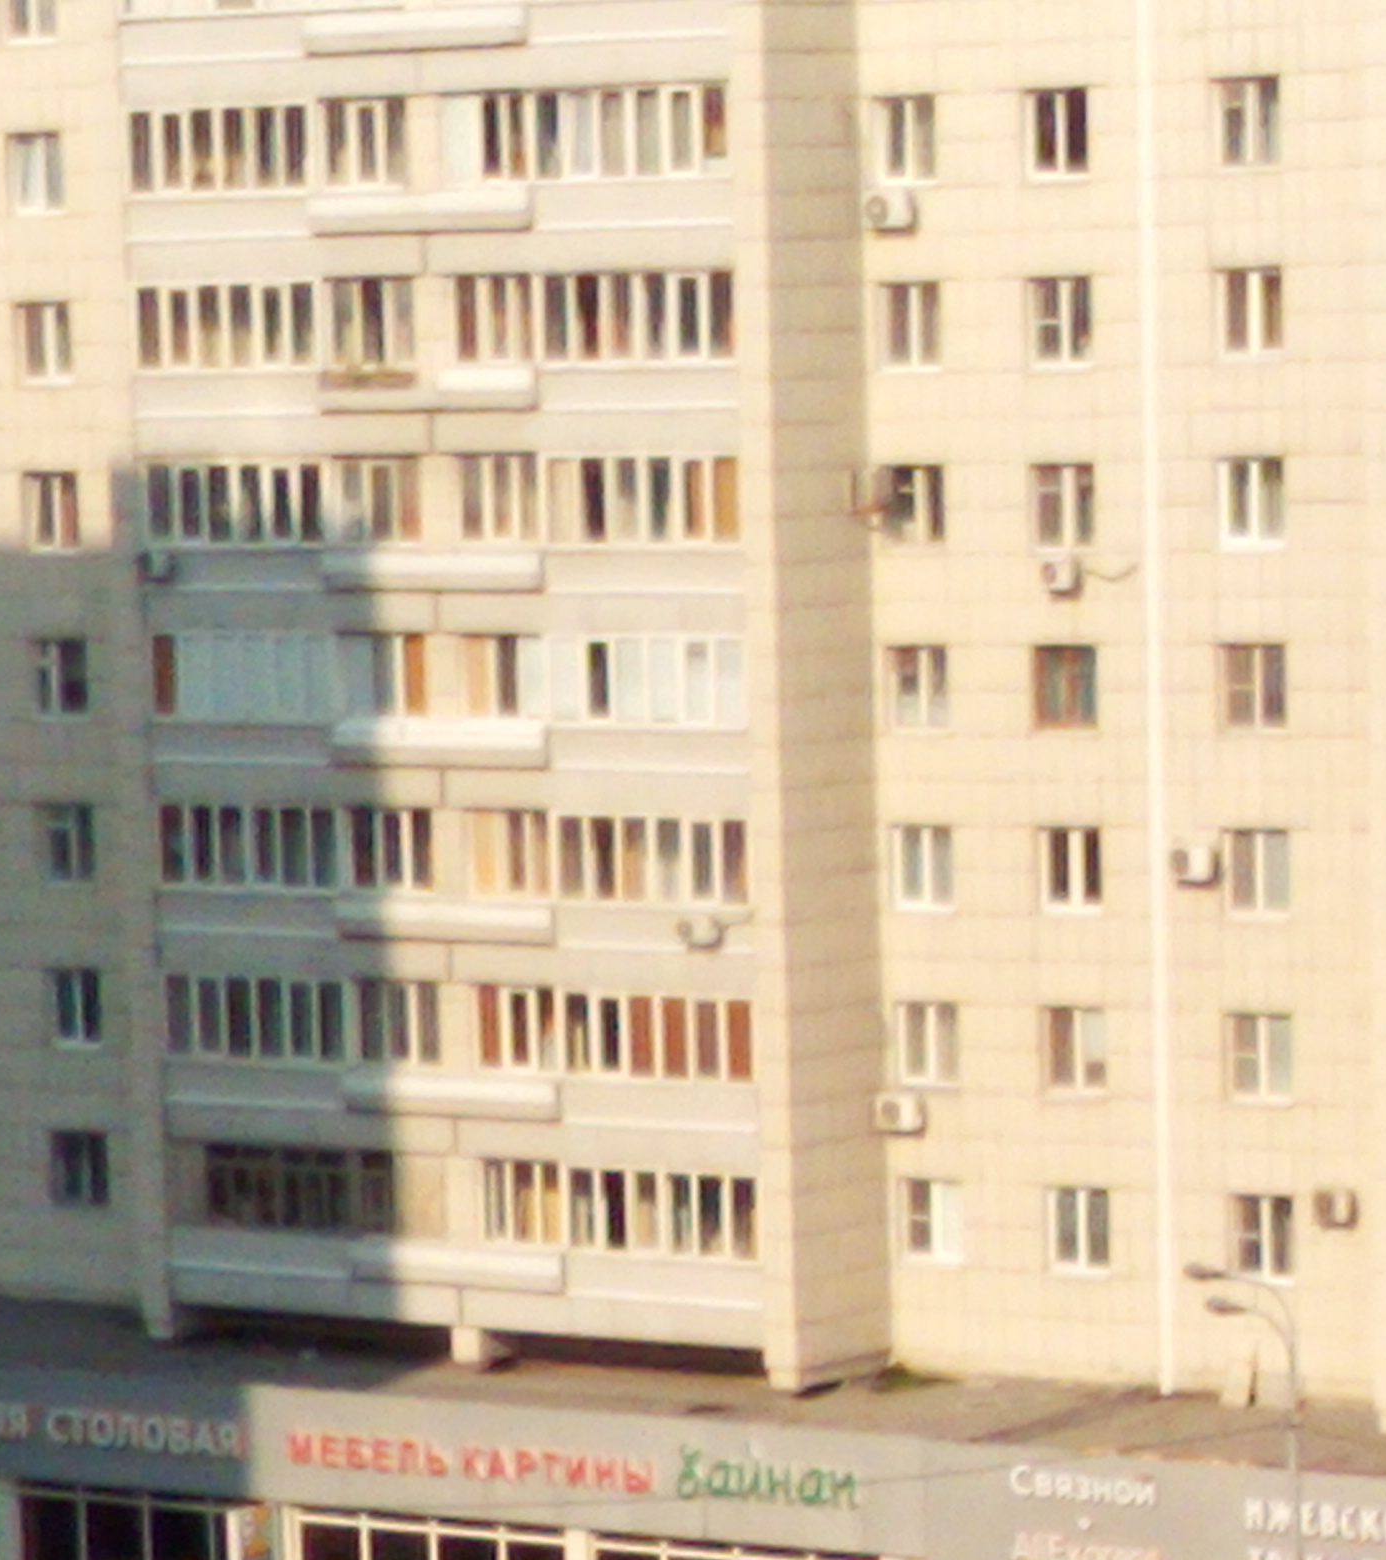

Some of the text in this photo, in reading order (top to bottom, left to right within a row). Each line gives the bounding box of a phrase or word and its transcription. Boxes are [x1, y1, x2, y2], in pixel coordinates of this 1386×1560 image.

[45, 1406, 250, 1461] СТОЛОВАЯ
[286, 1430, 654, 1495] МЕБЕЛЬ КАРТИНЫ
[1010, 1463, 1157, 1507] Связной
